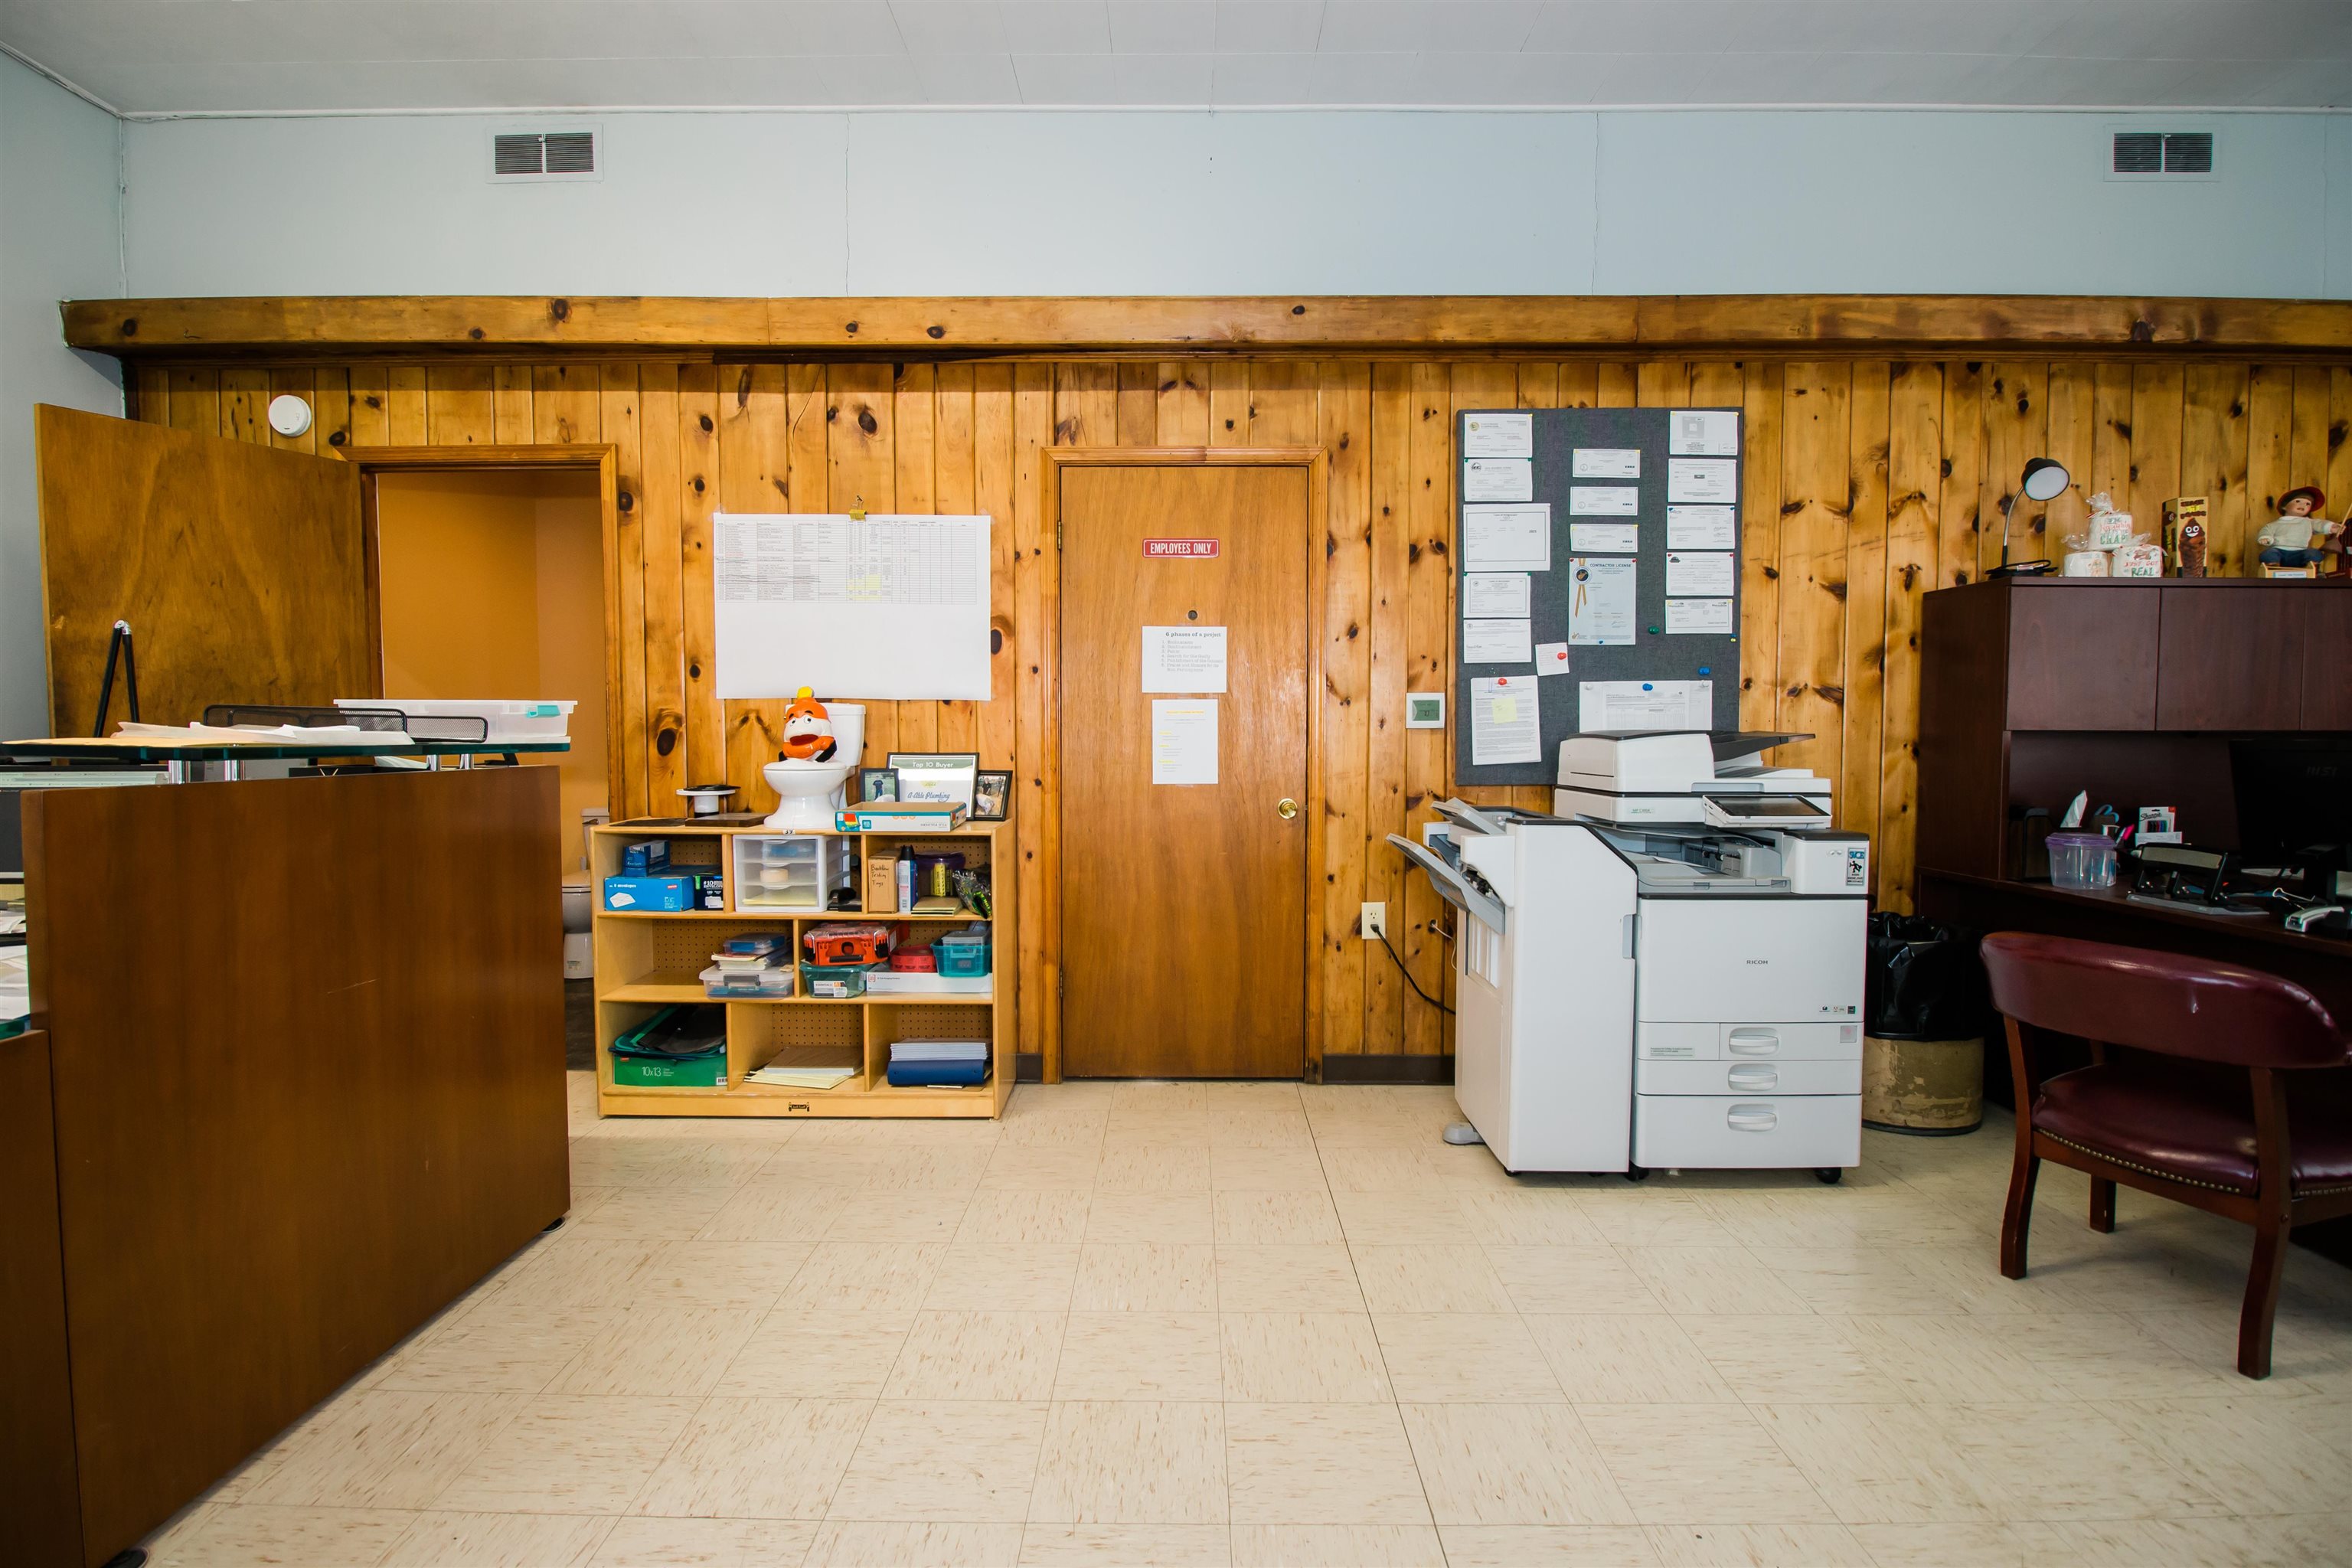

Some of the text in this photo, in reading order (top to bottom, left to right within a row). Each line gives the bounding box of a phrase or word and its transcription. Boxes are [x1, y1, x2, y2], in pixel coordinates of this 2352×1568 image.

[1150, 542, 1211, 554] EMPLOYEES ONLY
[2132, 567, 2153, 577] REAL
[925, 791, 951, 802] Plumbing
[642, 1066, 662, 1077] 10x13
